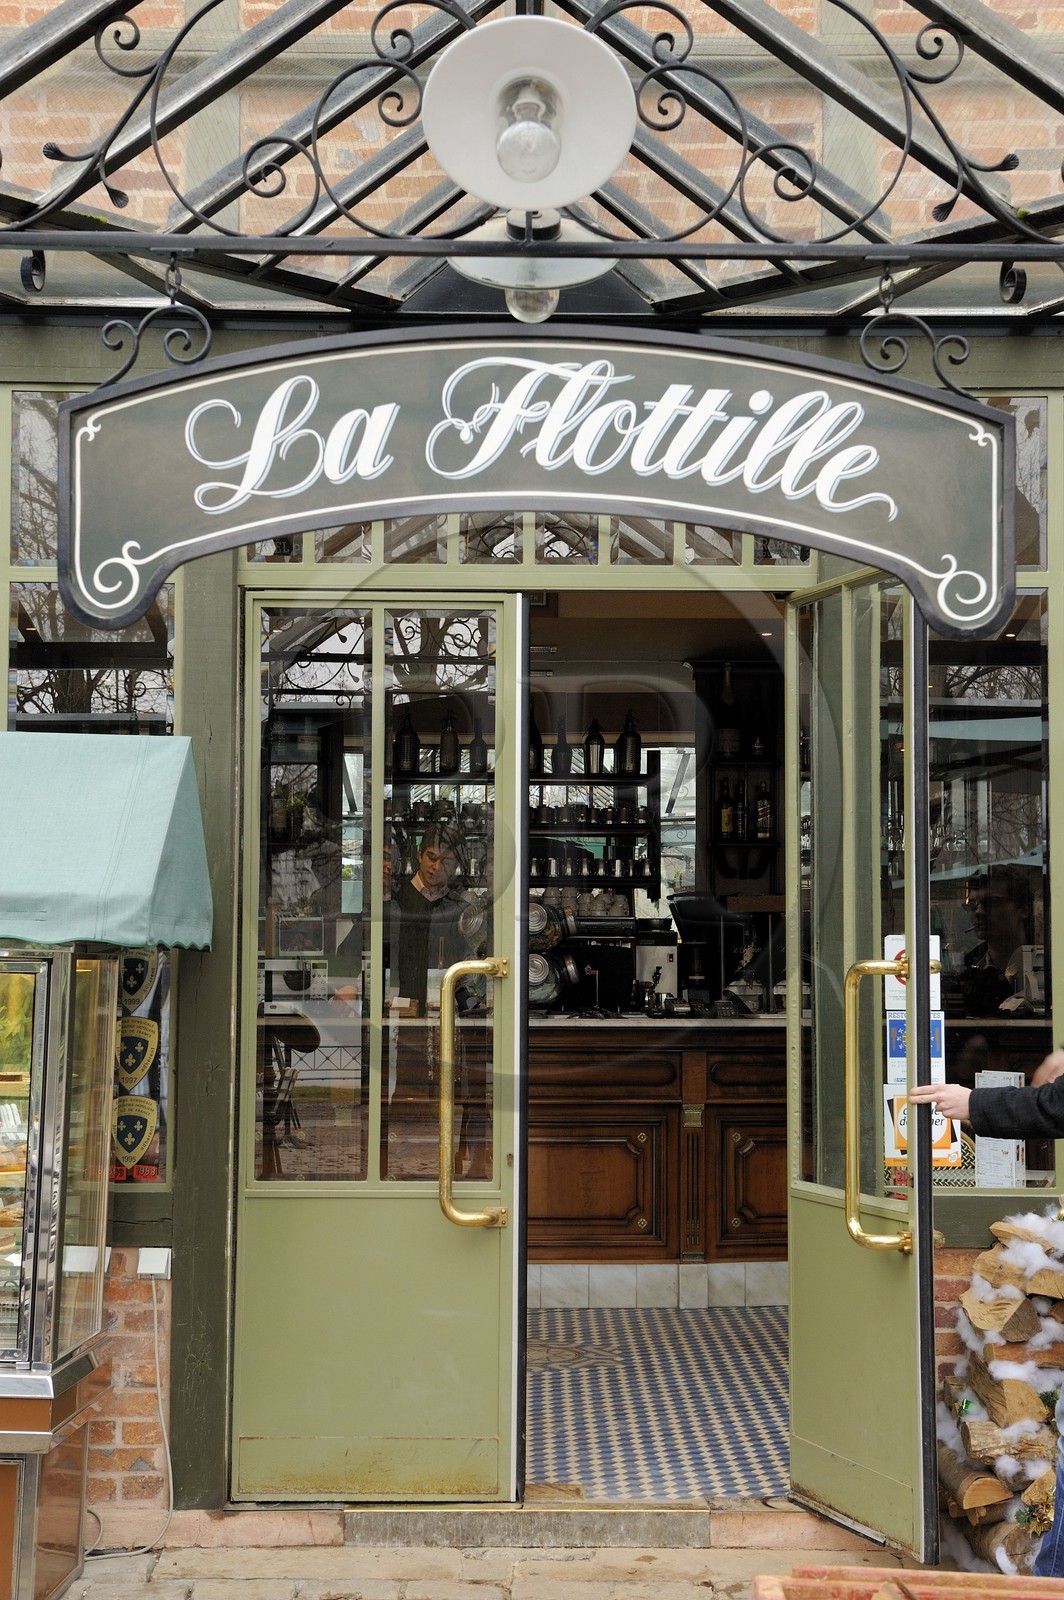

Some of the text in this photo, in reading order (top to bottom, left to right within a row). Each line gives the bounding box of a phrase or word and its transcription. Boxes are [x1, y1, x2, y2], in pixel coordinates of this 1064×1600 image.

[184, 356, 899, 521] La Flottille
[121, 1155, 137, 1163] 1995
